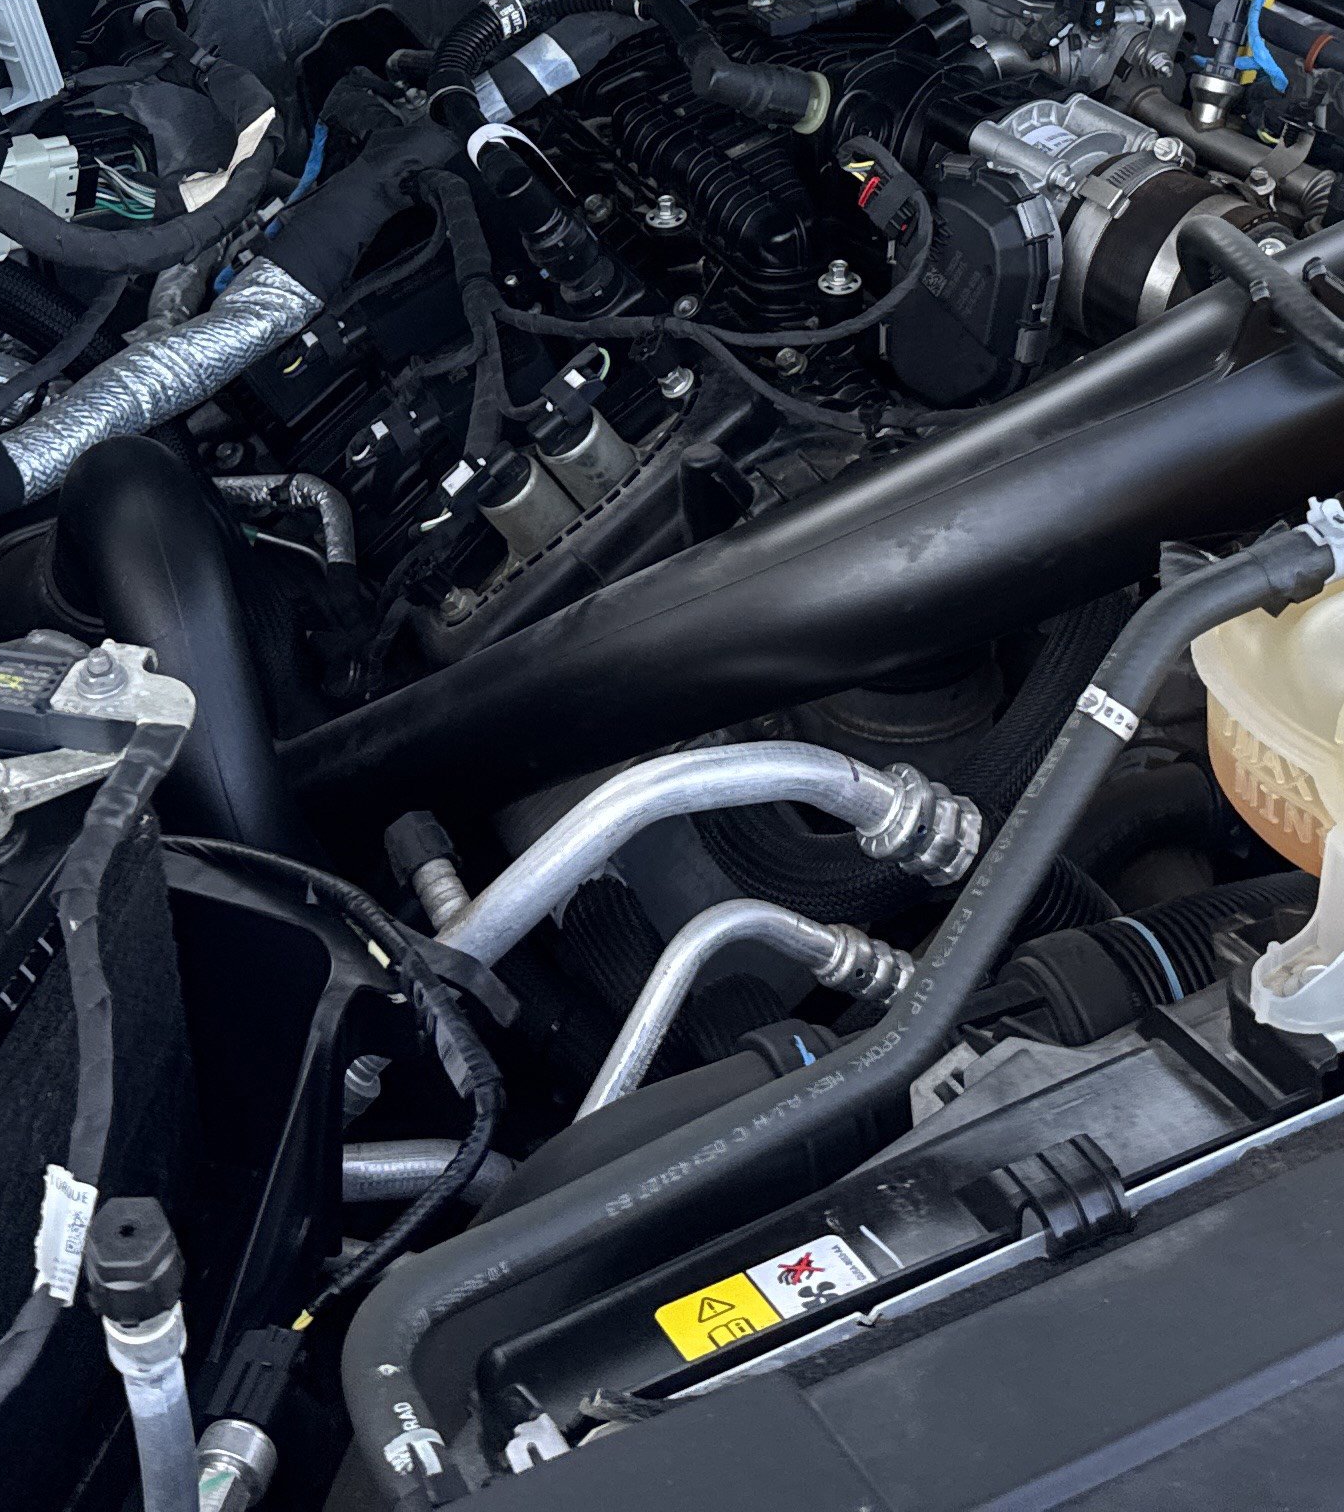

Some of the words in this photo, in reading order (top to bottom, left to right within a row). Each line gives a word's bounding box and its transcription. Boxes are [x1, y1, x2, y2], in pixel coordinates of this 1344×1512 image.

[1232, 725, 1314, 801] MAX
[1234, 762, 1314, 844] MIN
[393, 1401, 421, 1432] RAD
